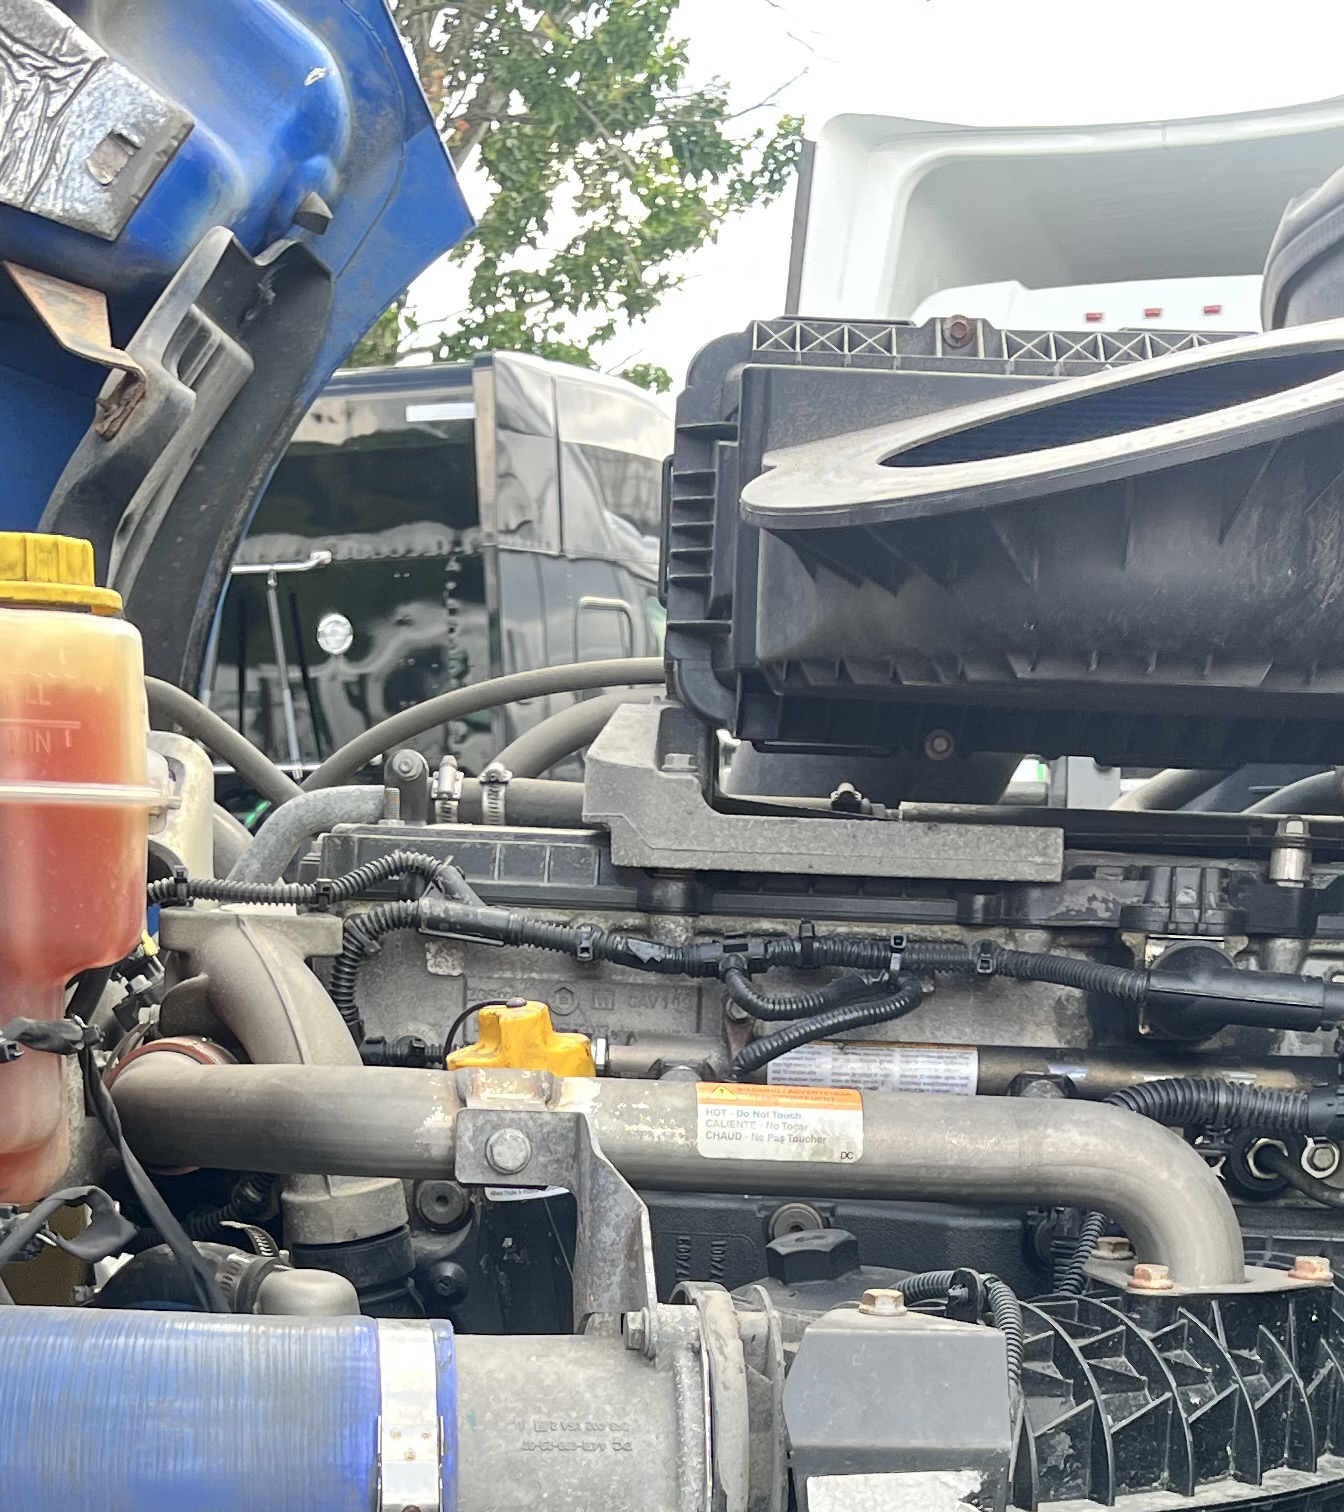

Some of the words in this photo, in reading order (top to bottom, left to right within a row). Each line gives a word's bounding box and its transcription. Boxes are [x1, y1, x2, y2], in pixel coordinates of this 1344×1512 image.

[705, 1108, 727, 1117] HOT
[736, 1109, 750, 1118] Do
[752, 1110, 770, 1119] Not
[772, 1110, 802, 1120] Touch
[705, 1119, 756, 1130] CALIENTE
[766, 1121, 780, 1130] No
[705, 1131, 742, 1141] CHAUD
[751, 1132, 765, 1142] Ne
[788, 1133, 827, 1145] Toucher
[840, 1151, 854, 1160] DC
